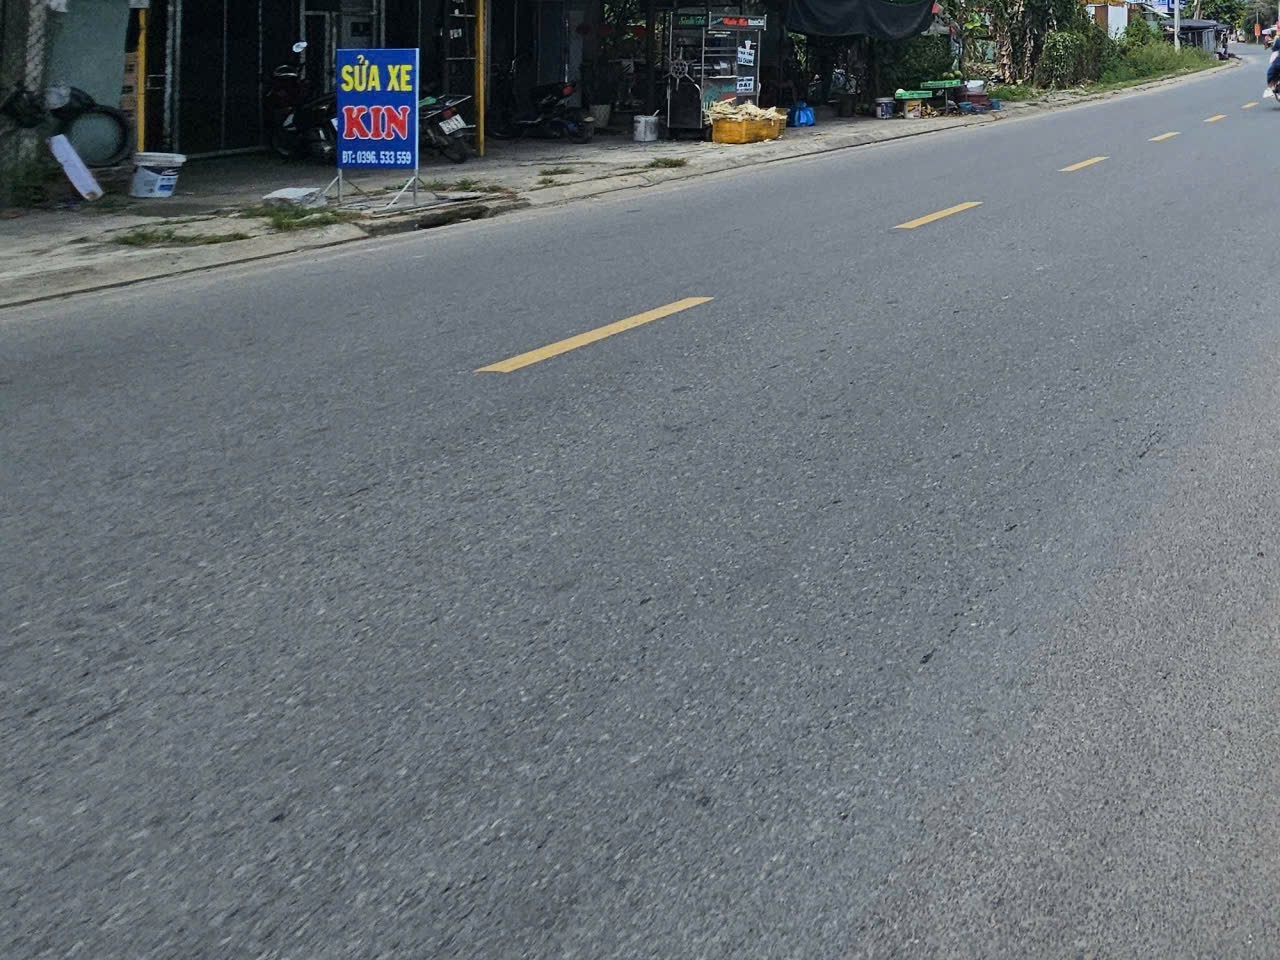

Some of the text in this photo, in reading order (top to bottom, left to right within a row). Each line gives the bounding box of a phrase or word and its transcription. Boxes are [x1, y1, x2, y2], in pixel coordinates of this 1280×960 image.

[341, 54, 412, 92] SỬA XE
[342, 105, 411, 140] KIN
[342, 150, 412, 165] ĐT: 0396. 533 559
